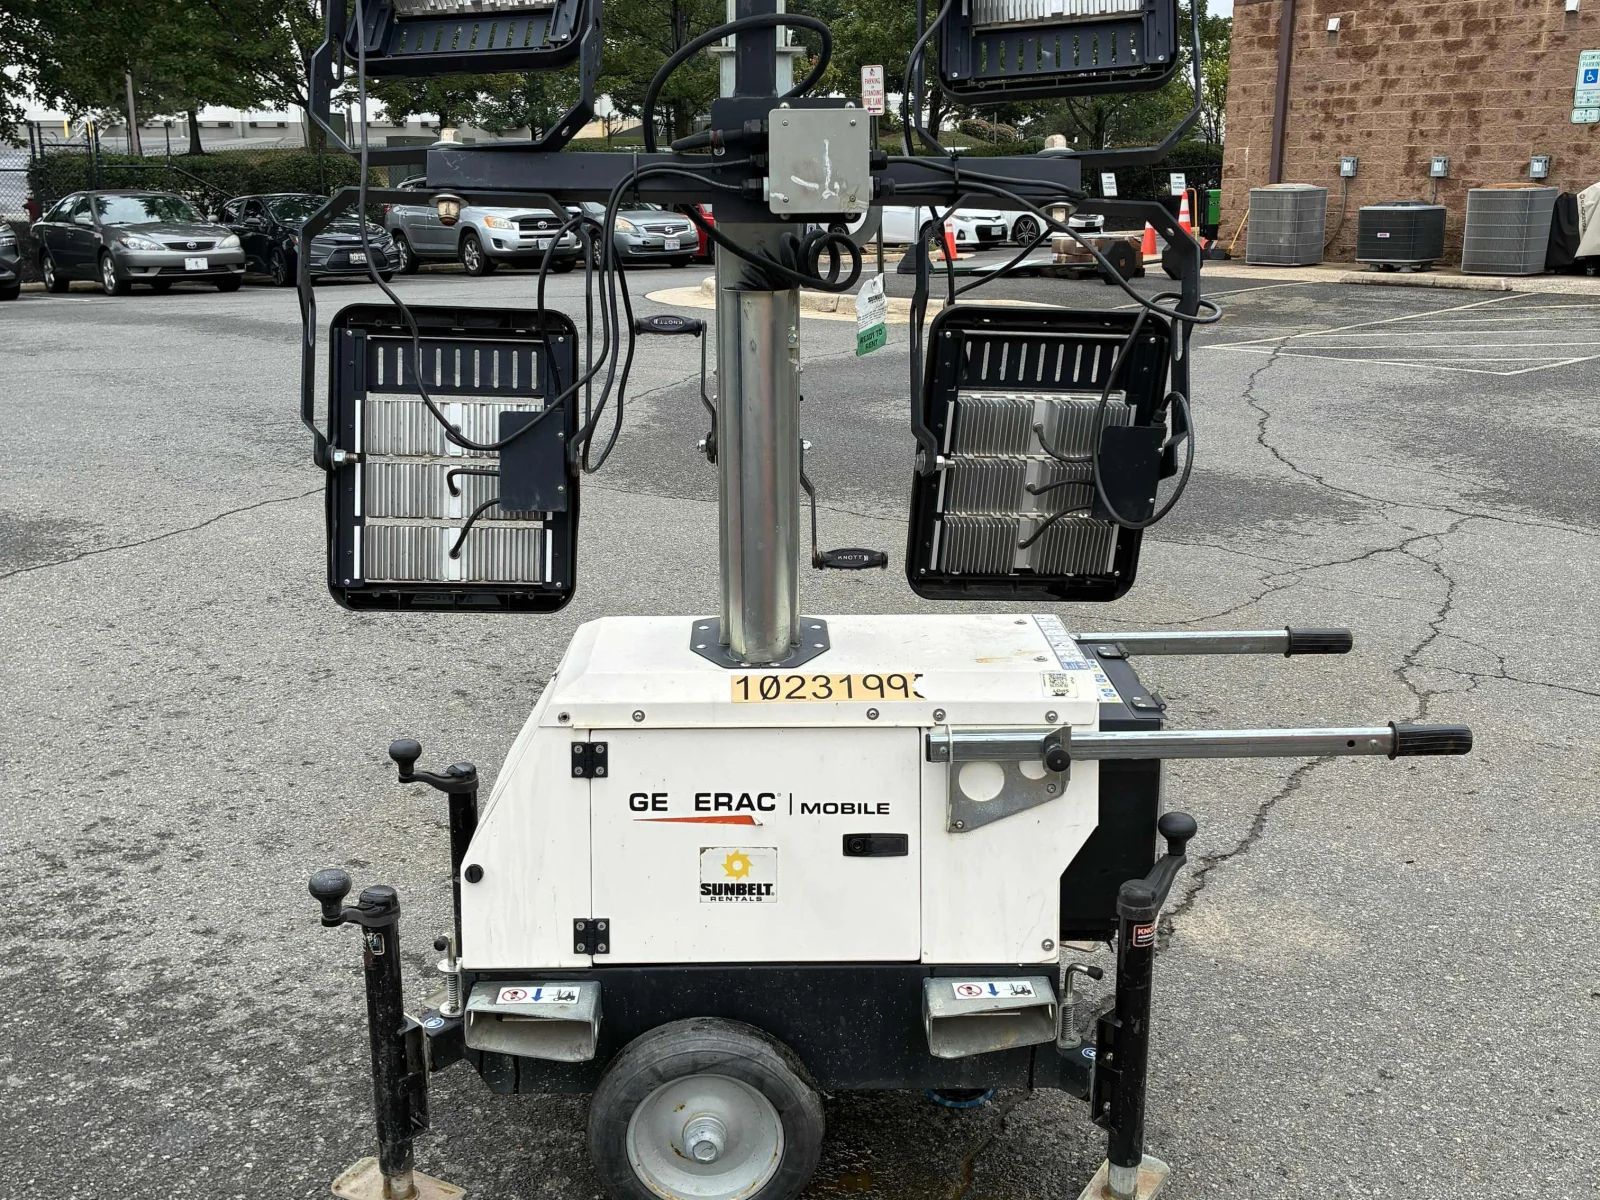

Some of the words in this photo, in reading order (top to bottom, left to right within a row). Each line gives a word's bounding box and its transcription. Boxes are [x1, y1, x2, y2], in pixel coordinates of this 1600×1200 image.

[860, 332, 875, 343] READY
[865, 339, 878, 350] RENT
[800, 803, 890, 815] MOBILE
[701, 883, 773, 896] SUNBELT
